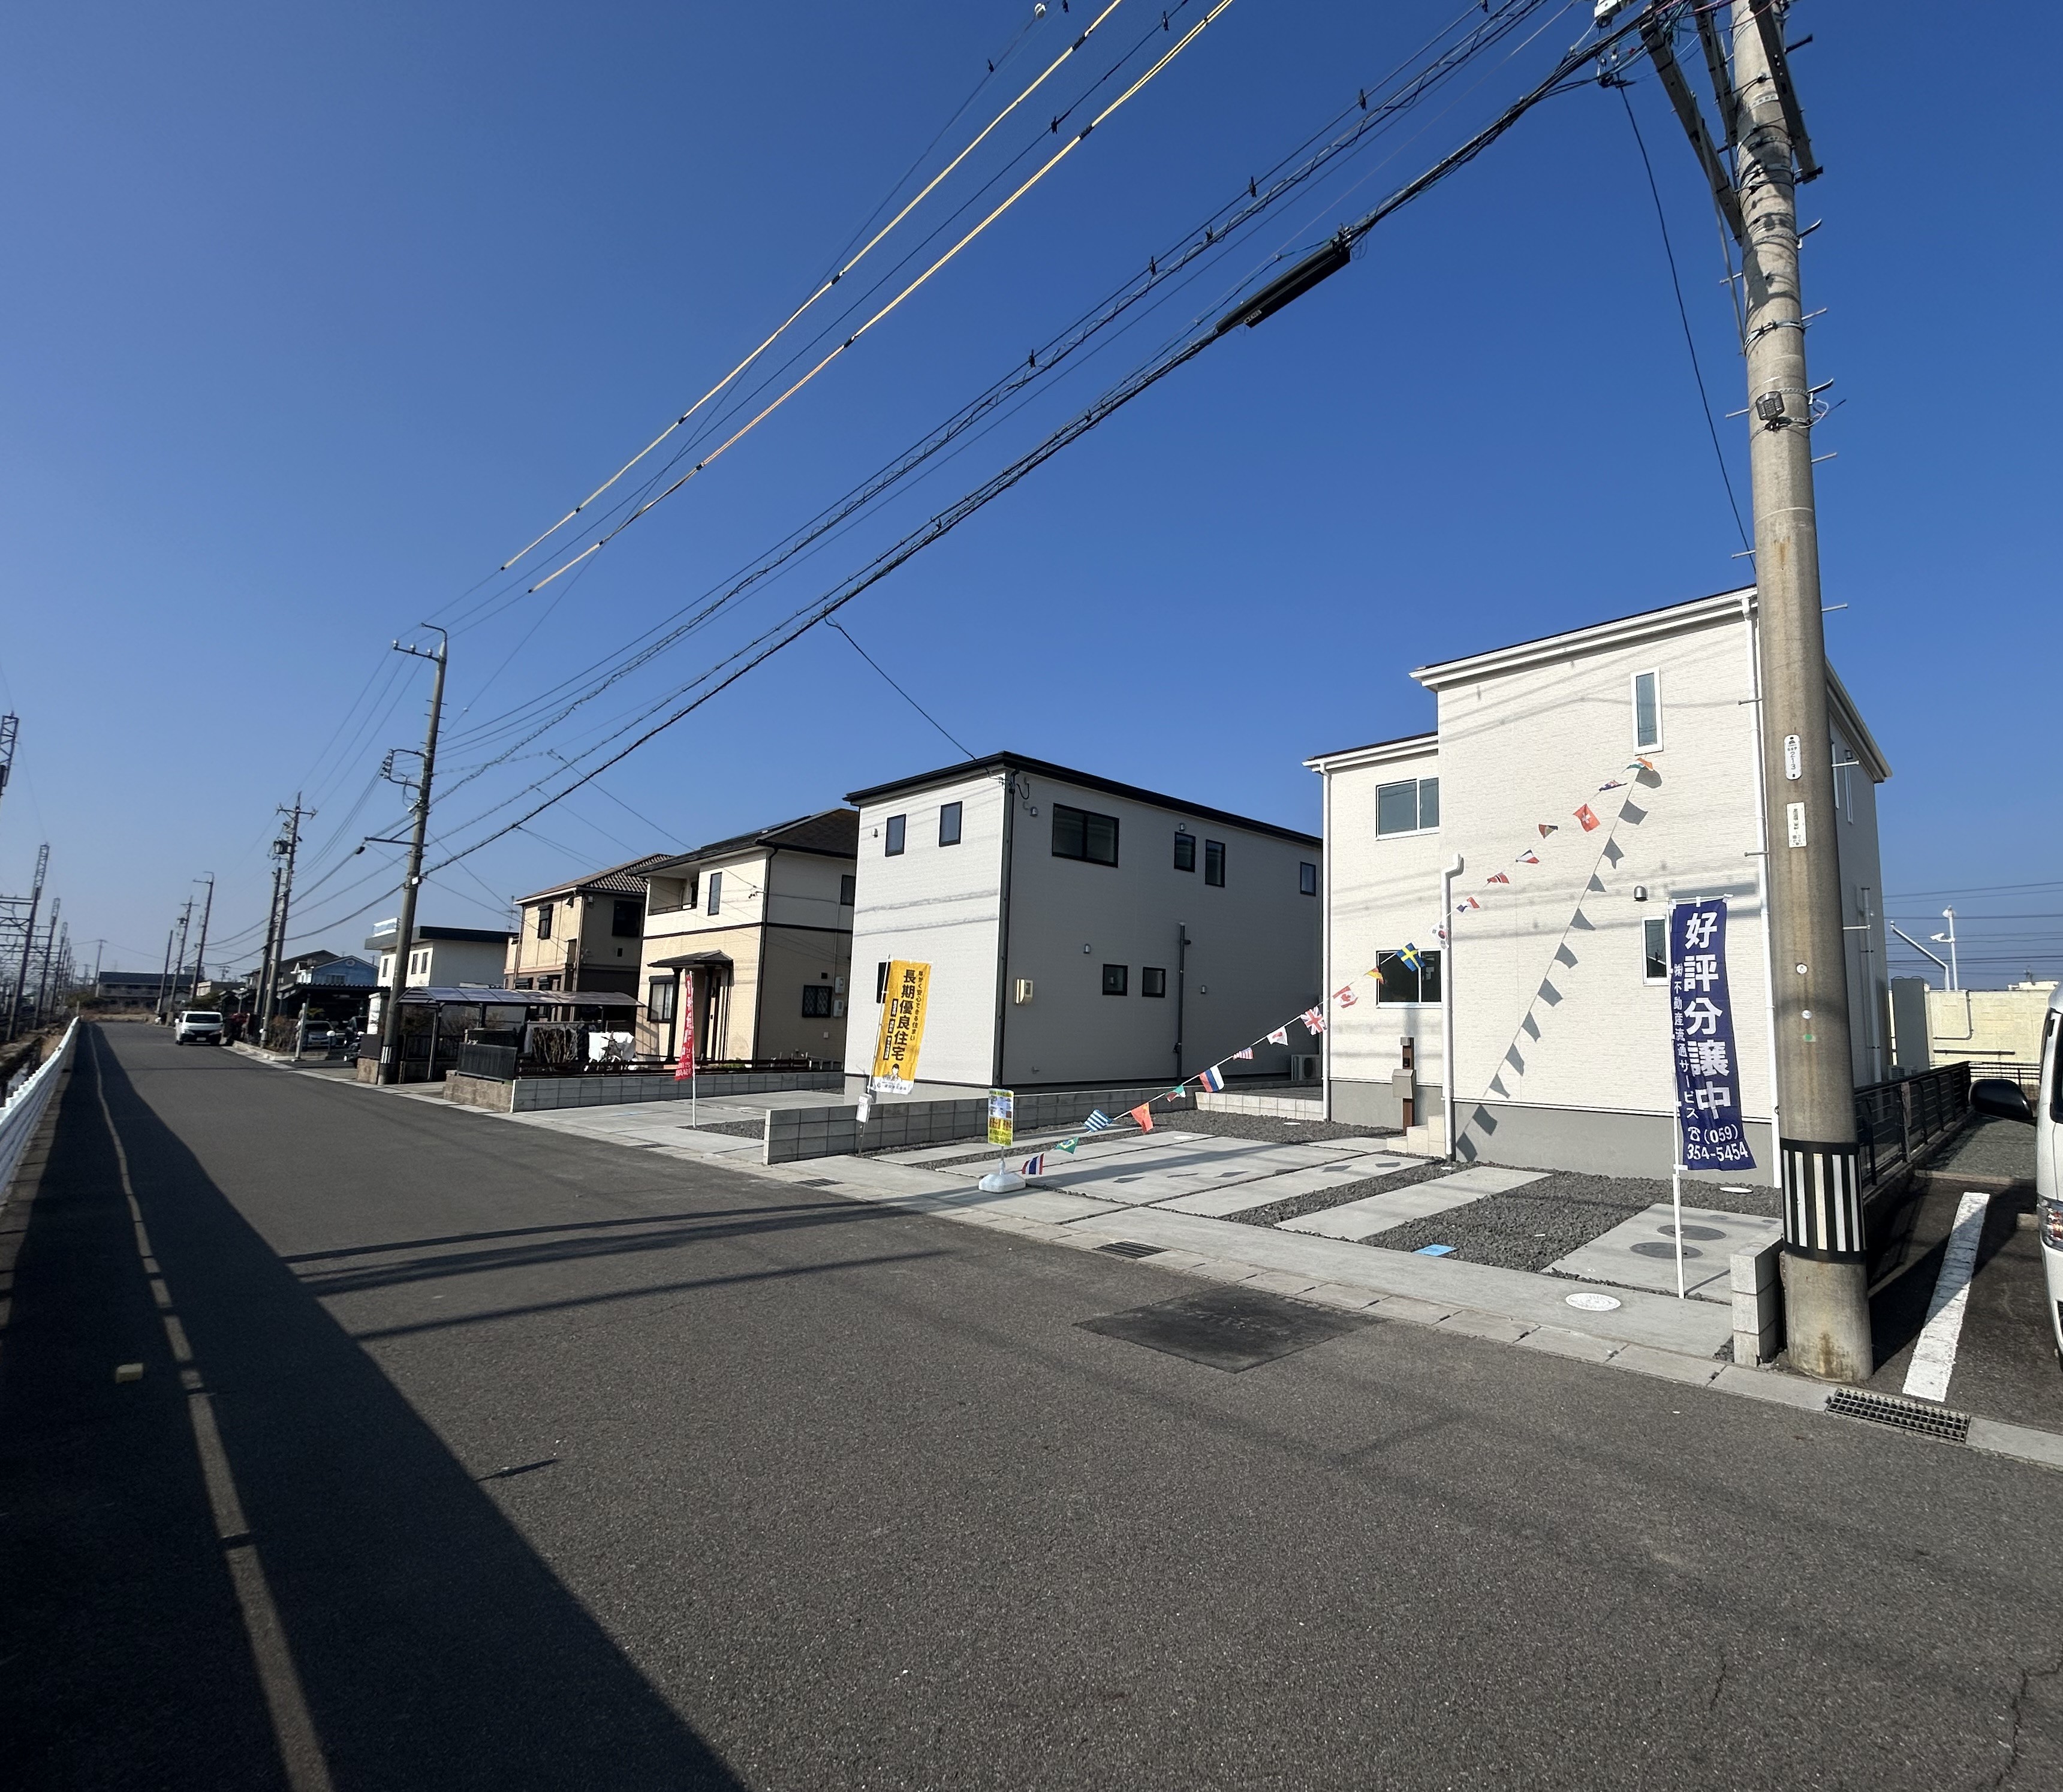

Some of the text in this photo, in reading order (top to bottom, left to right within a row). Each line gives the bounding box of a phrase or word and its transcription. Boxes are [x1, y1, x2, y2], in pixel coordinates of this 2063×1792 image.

[892, 969, 916, 1061] 長期優良住宅
[1683, 912, 1731, 1120] 好評分譲中
[1687, 1141, 1749, 1162] 354-5454
